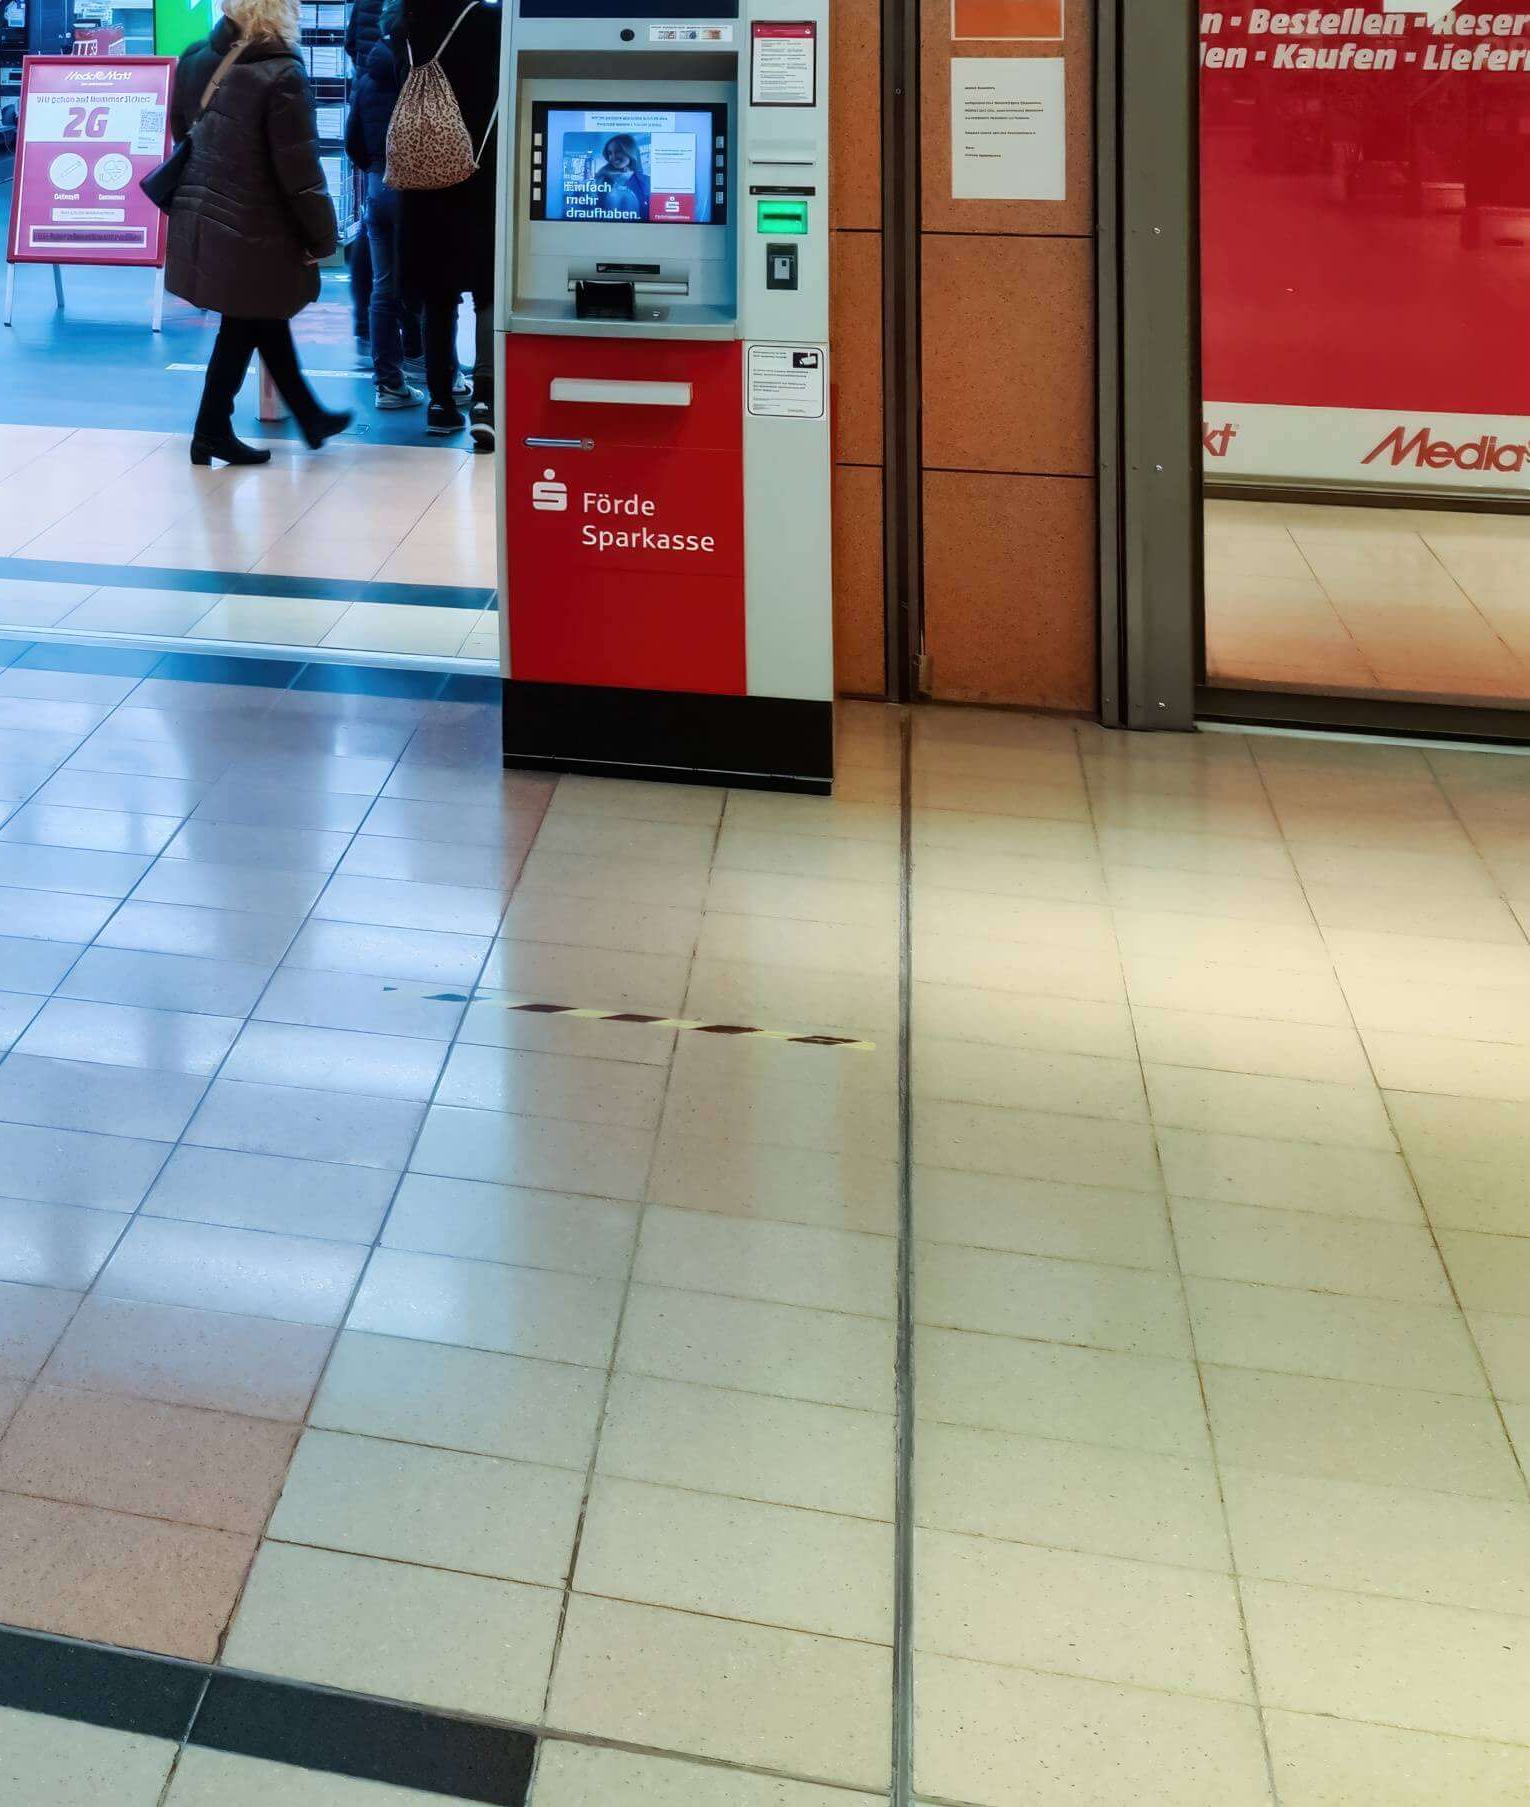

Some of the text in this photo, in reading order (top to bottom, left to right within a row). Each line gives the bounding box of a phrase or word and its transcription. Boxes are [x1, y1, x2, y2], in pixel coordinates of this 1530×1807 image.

[1248, 9, 1406, 35] Bestellen
[1273, 43, 1398, 70] Kaufen
[62, 105, 111, 139] 2G
[566, 194, 600, 206] mehr
[566, 207, 642, 220] draufhaben.
[1360, 425, 1526, 473] Media
[583, 492, 656, 517] Förde
[581, 524, 716, 553] Sparkasse
